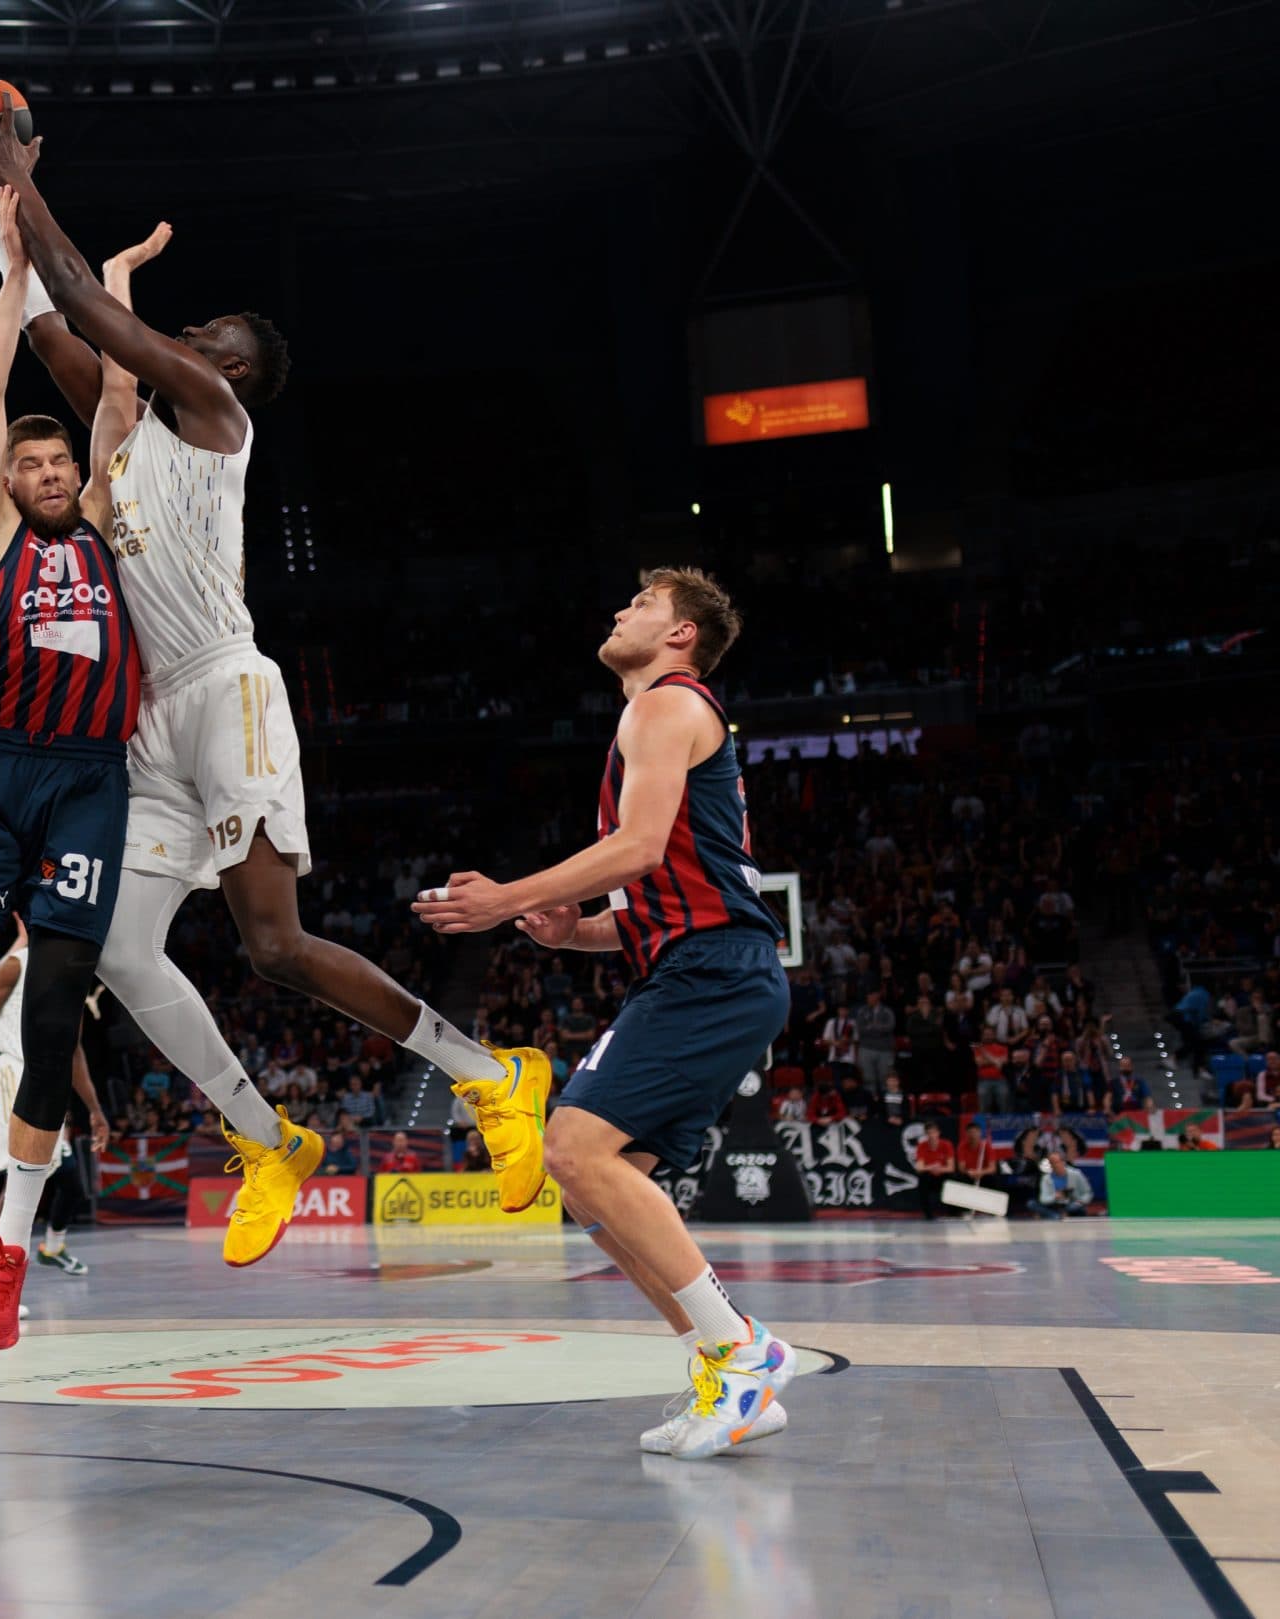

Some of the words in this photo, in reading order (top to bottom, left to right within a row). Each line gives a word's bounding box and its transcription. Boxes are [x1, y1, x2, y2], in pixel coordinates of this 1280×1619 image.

[39, 543, 83, 583] 31
[216, 815, 242, 850] 19
[56, 853, 103, 905] 31
